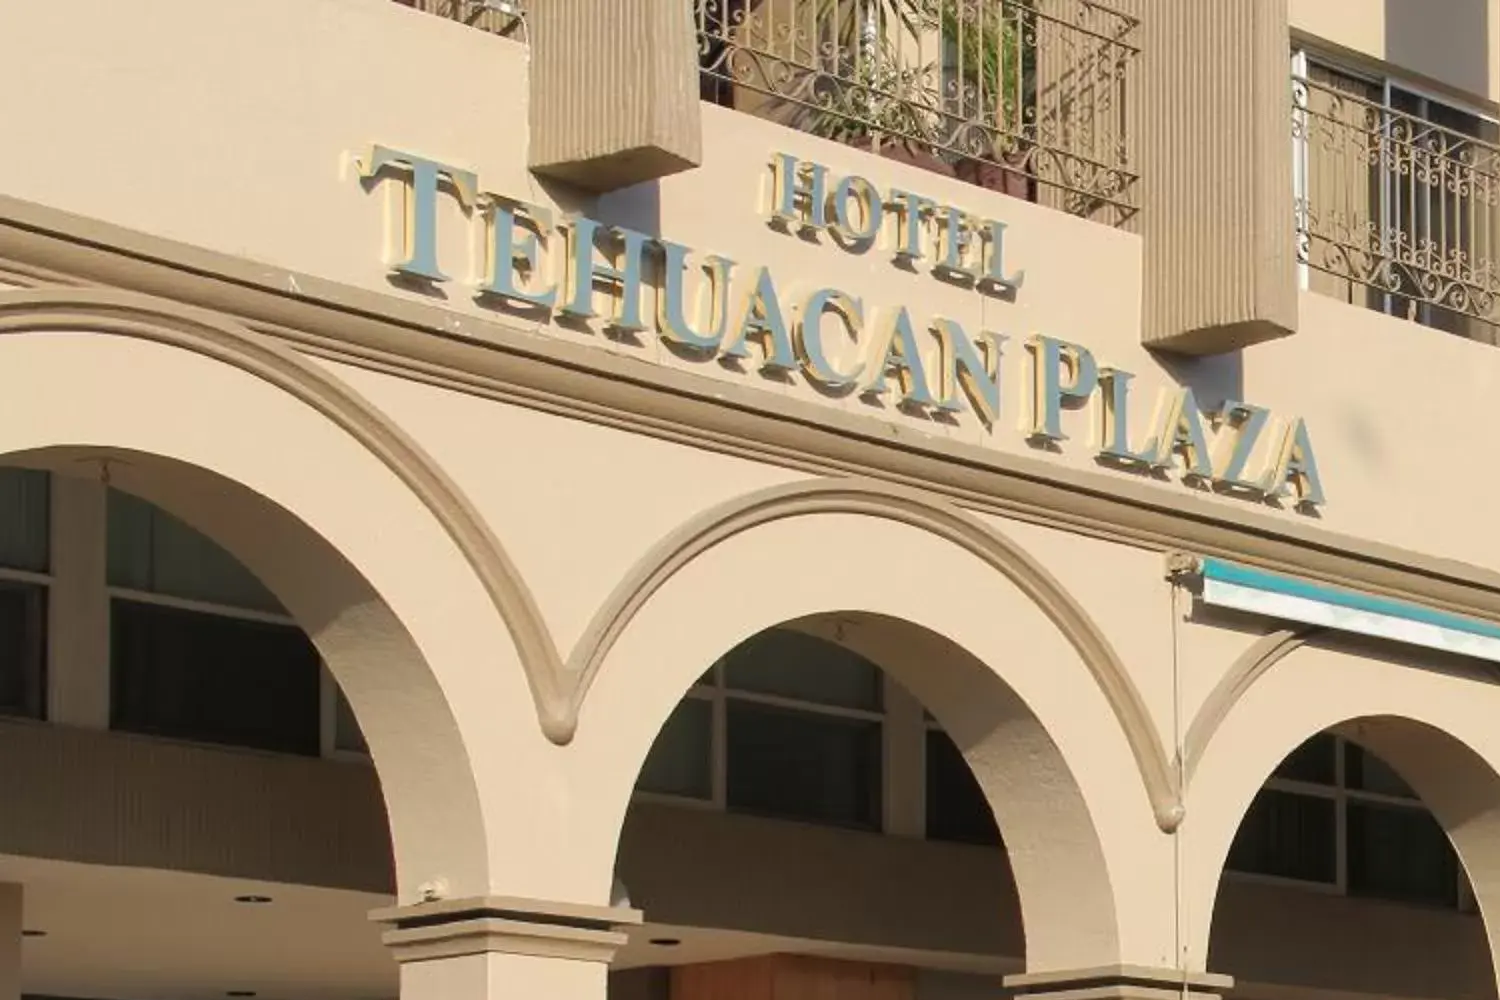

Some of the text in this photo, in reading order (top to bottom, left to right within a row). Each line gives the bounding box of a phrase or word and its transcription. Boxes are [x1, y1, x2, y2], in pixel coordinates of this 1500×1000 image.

[353, 144, 1327, 508] TEHUACAN PLAZA
[770, 150, 1024, 289] HOTEL
